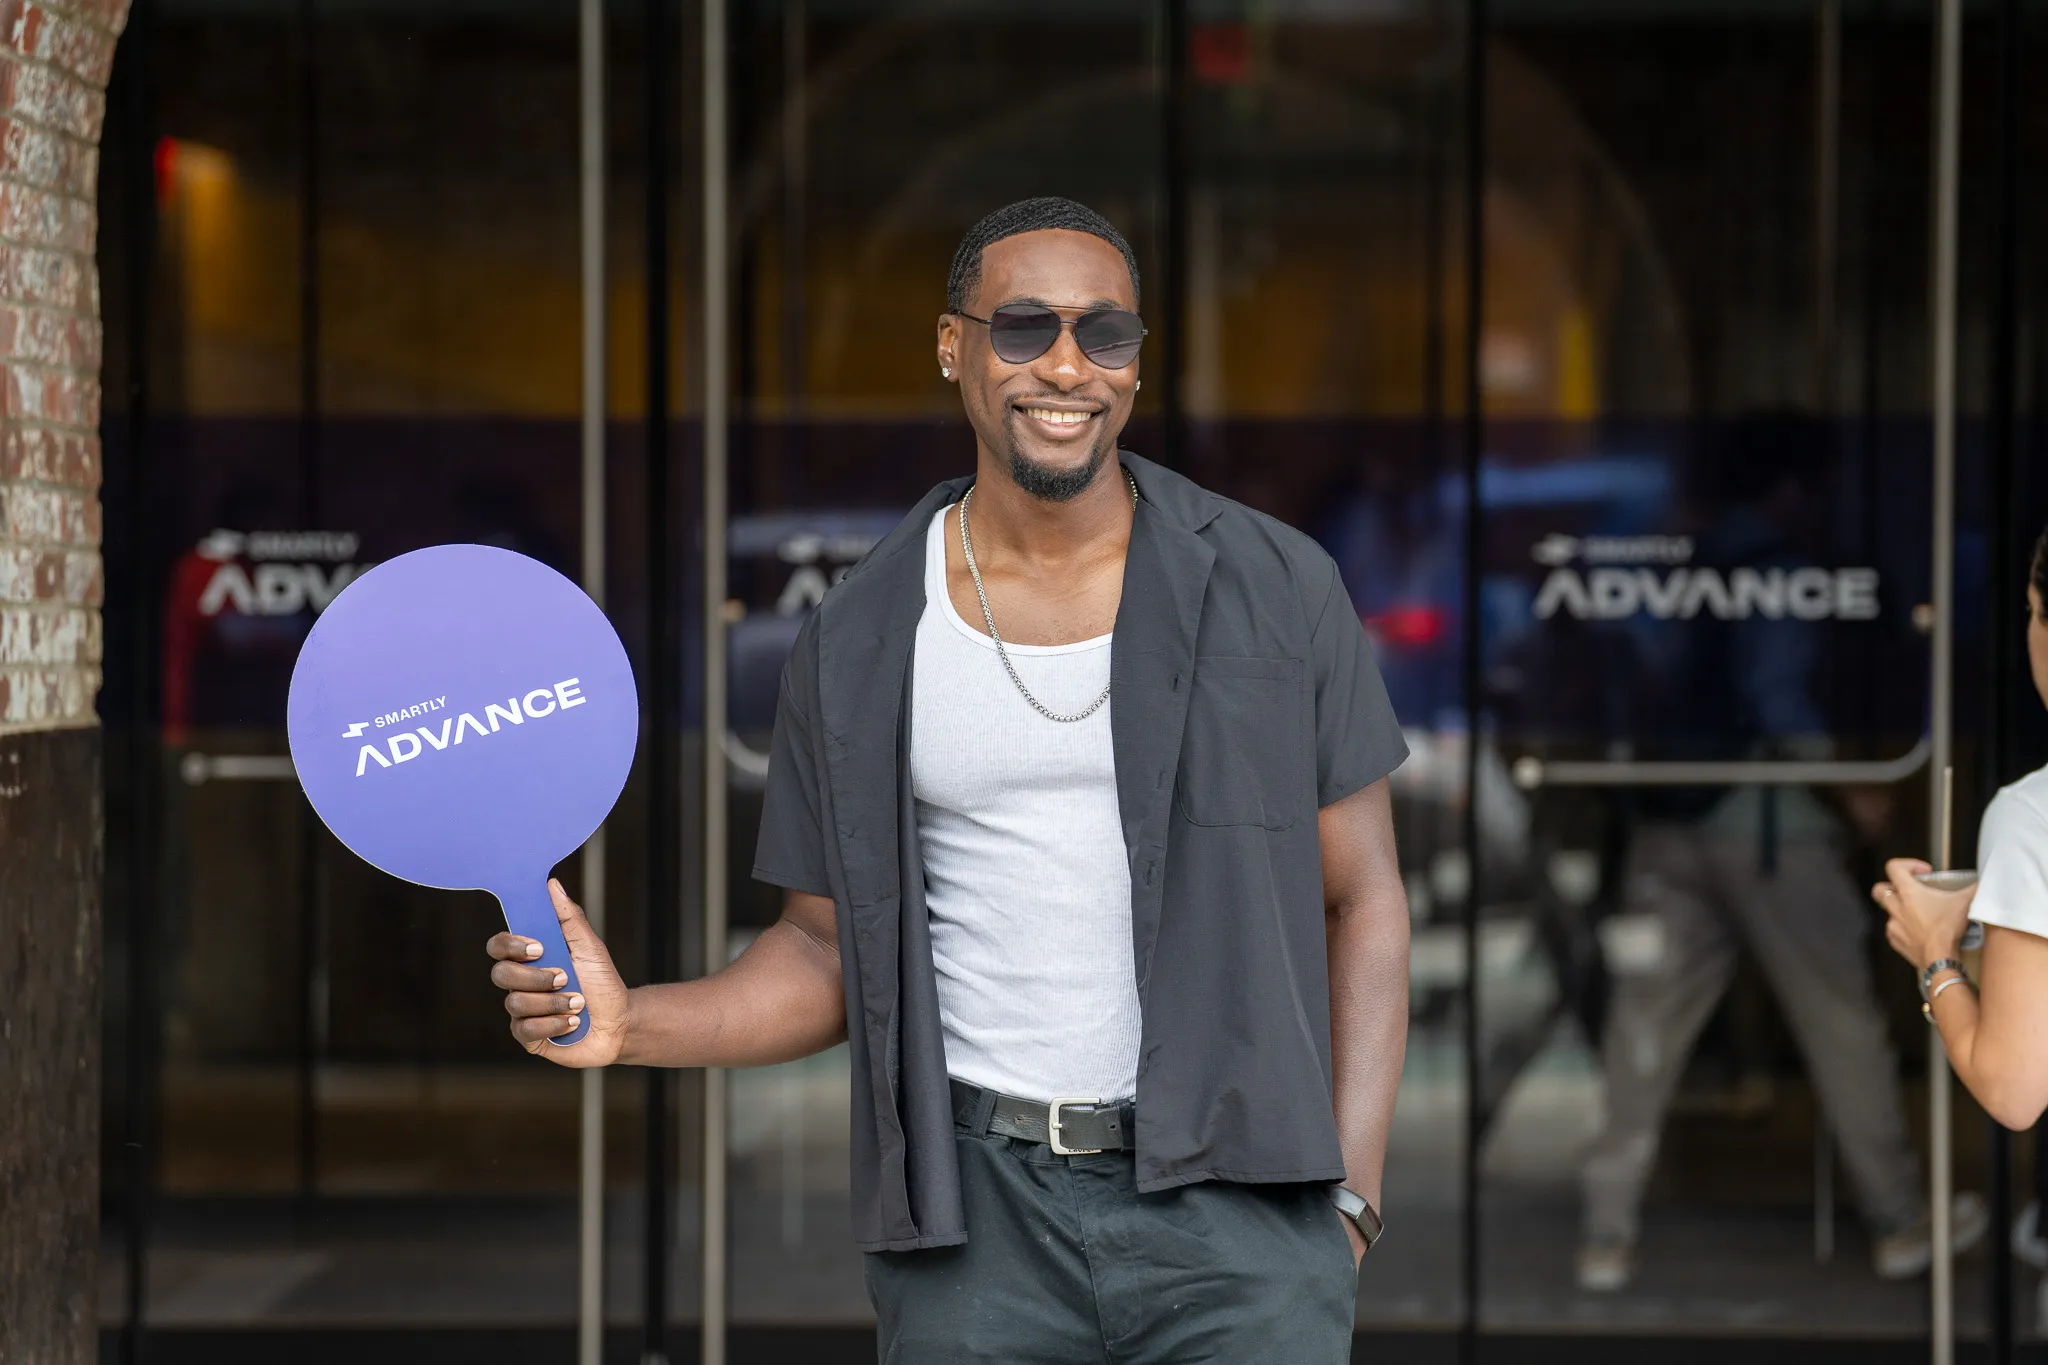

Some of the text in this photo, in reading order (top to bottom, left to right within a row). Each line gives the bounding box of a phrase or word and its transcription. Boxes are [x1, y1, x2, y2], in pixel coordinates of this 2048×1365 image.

[199, 563, 374, 615] ADV
[1533, 567, 1880, 620] ADVANCE
[355, 677, 587, 777] ADVANCE
[374, 695, 447, 728] SMARTLY
